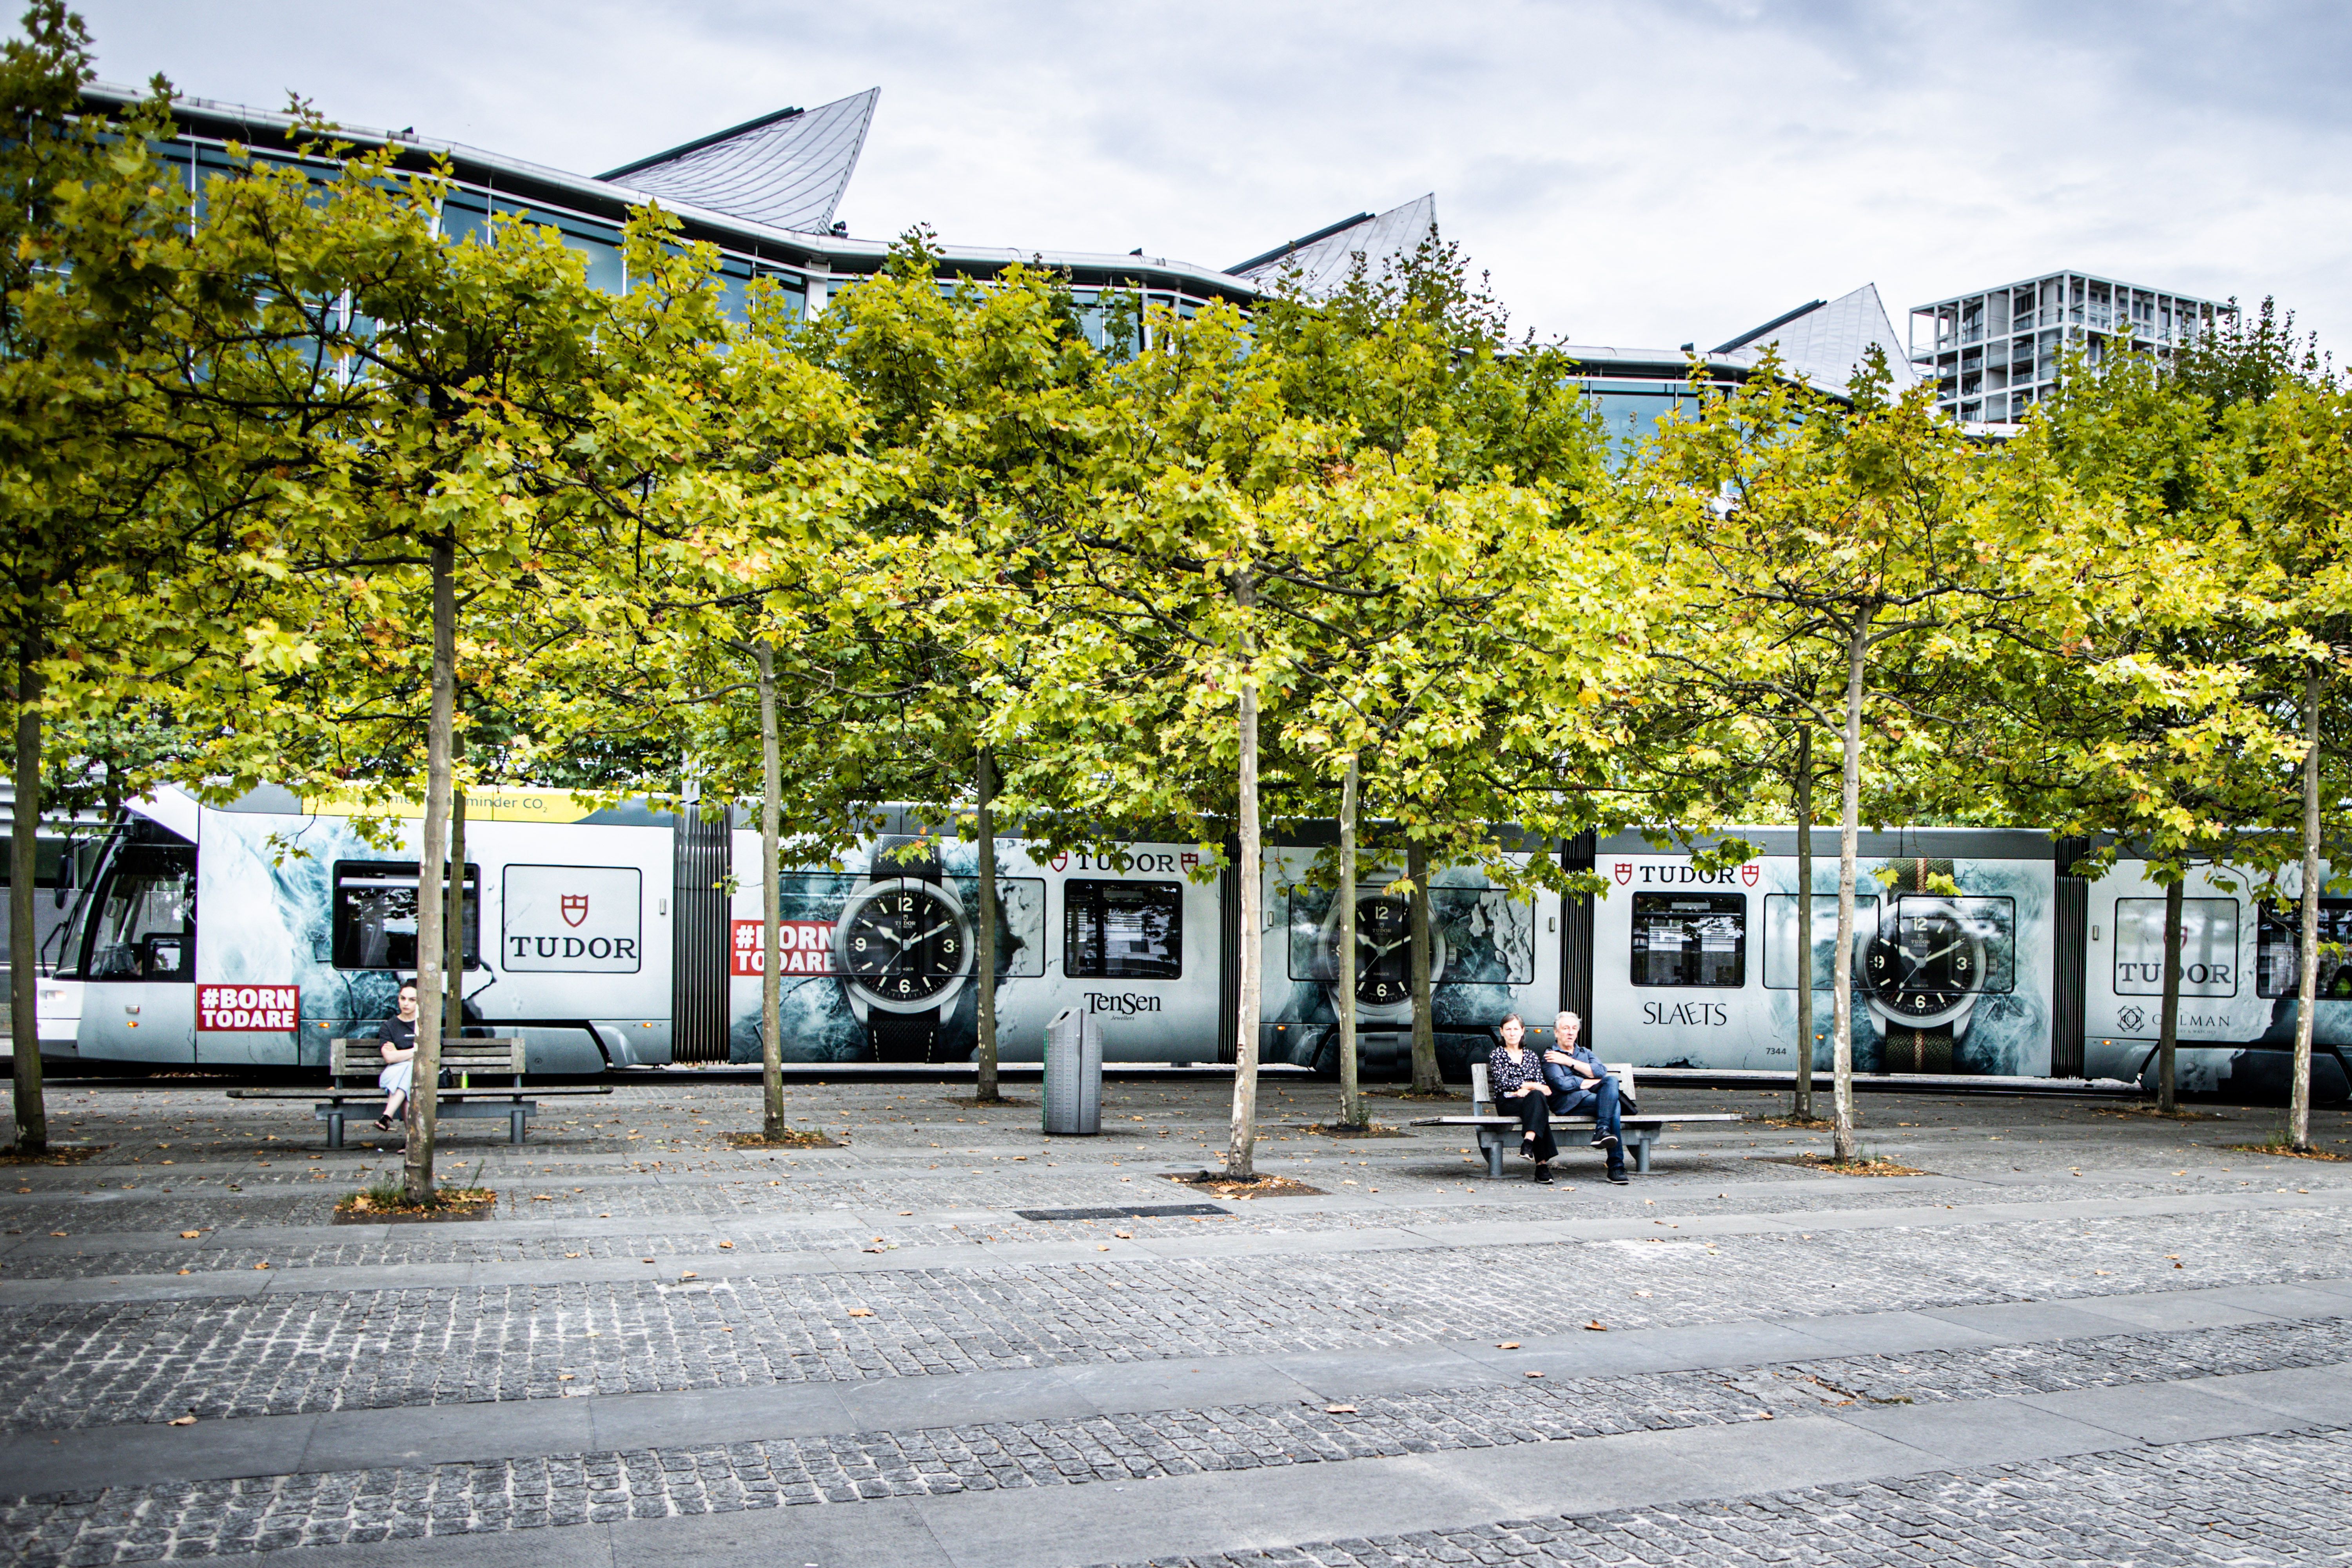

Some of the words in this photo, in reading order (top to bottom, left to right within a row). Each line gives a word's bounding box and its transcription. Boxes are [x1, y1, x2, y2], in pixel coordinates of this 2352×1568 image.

[466, 796, 518, 808] minder
[1640, 866, 1735, 884] TUDOR
[898, 897, 913, 911] 12
[1375, 906, 1389, 920] 12
[1913, 917, 1928, 931] 12
[510, 936, 637, 958] TUDOR
[855, 937, 867, 952] 9
[943, 939, 955, 953] 3
[1956, 957, 1967, 970] 3
[2118, 963, 2232, 984] TUOR
[899, 979, 910, 993] 6
[1377, 984, 1387, 997] 6
[201, 988, 295, 1009] #BORN
[1084, 993, 1161, 1015] TenSen
[1915, 995, 1926, 1009] 6
[201, 1010, 295, 1027] TODARE
[1643, 1002, 1727, 1026] SLAETS
[2152, 1014, 2230, 1026] CLMAN
